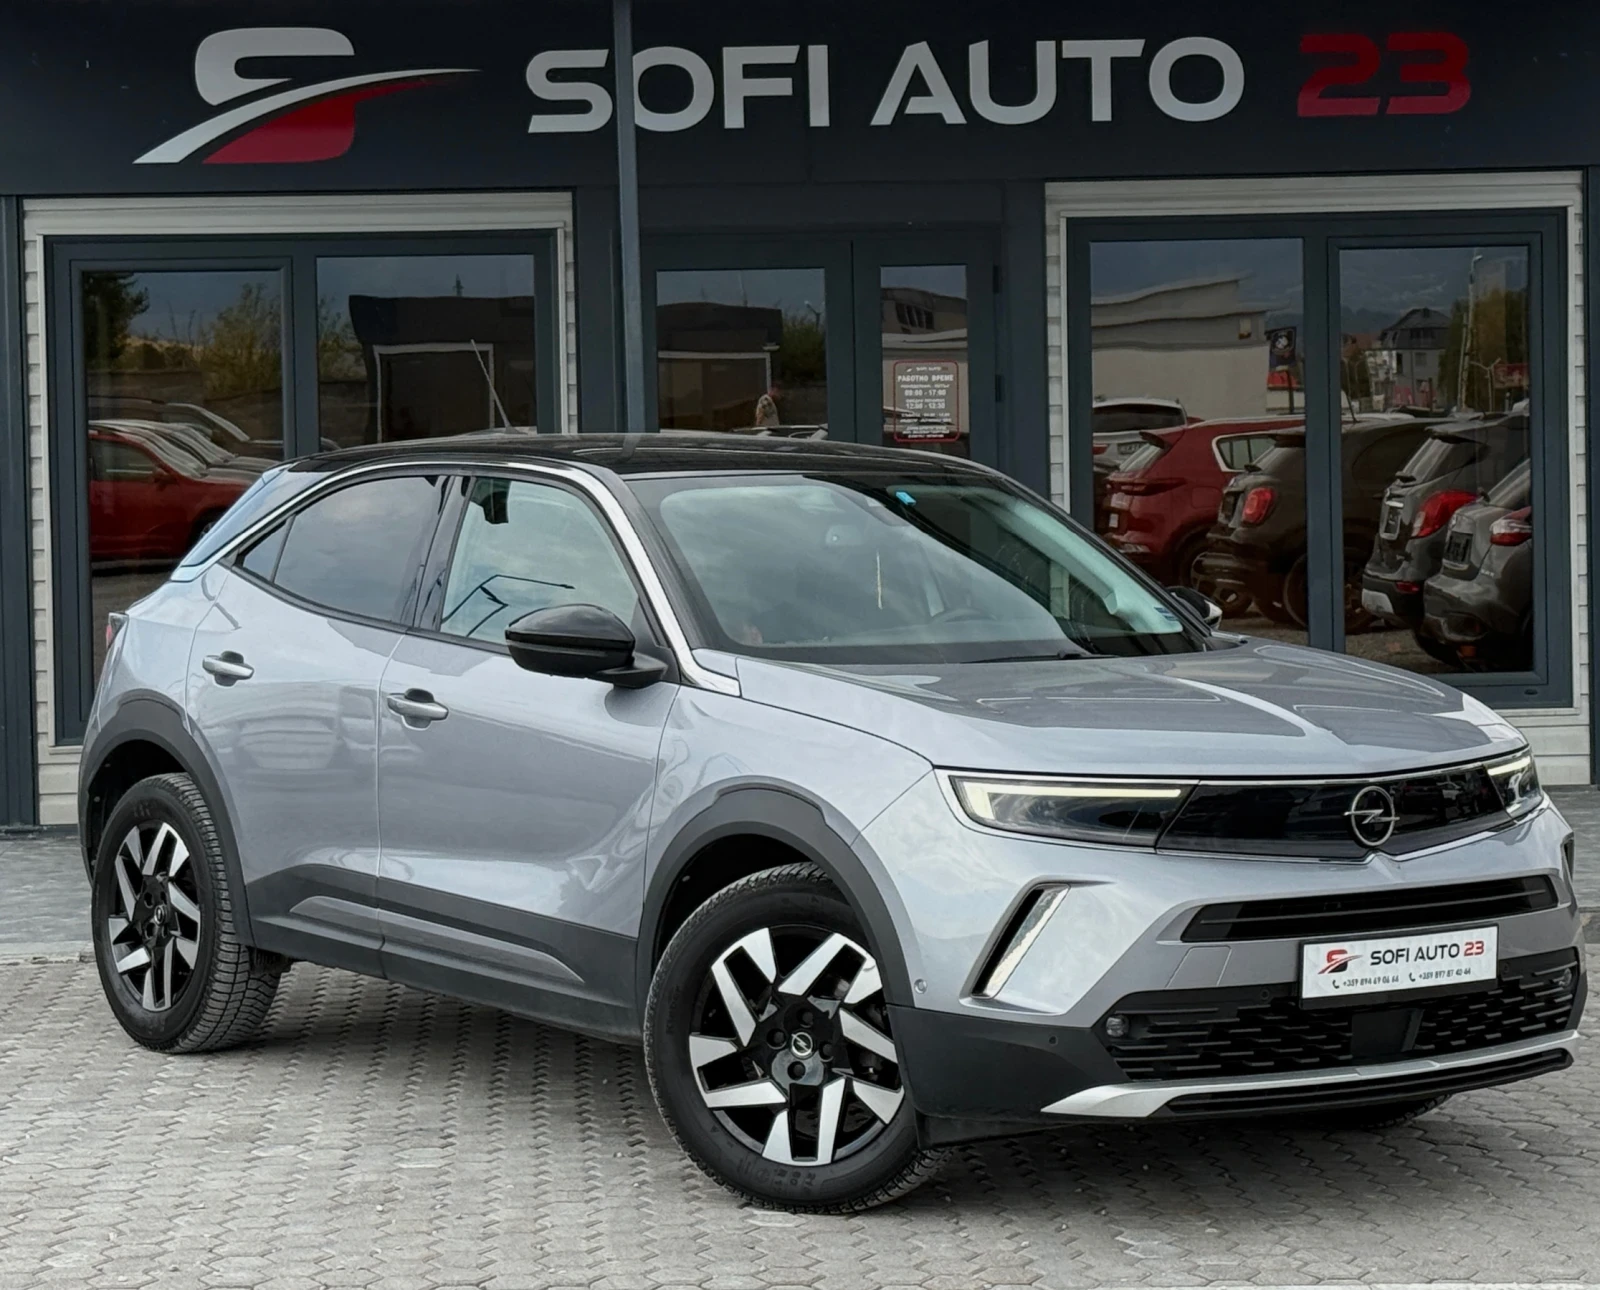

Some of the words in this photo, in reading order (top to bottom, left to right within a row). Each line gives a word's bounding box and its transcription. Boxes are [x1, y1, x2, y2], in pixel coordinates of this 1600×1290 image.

[526, 45, 830, 133] SOFI
[870, 36, 1245, 126] AUTO
[1297, 32, 1471, 117] 23
[1370, 948, 1410, 966] SOFI
[1413, 943, 1460, 962] AUTO
[1463, 941, 1485, 957] 23
